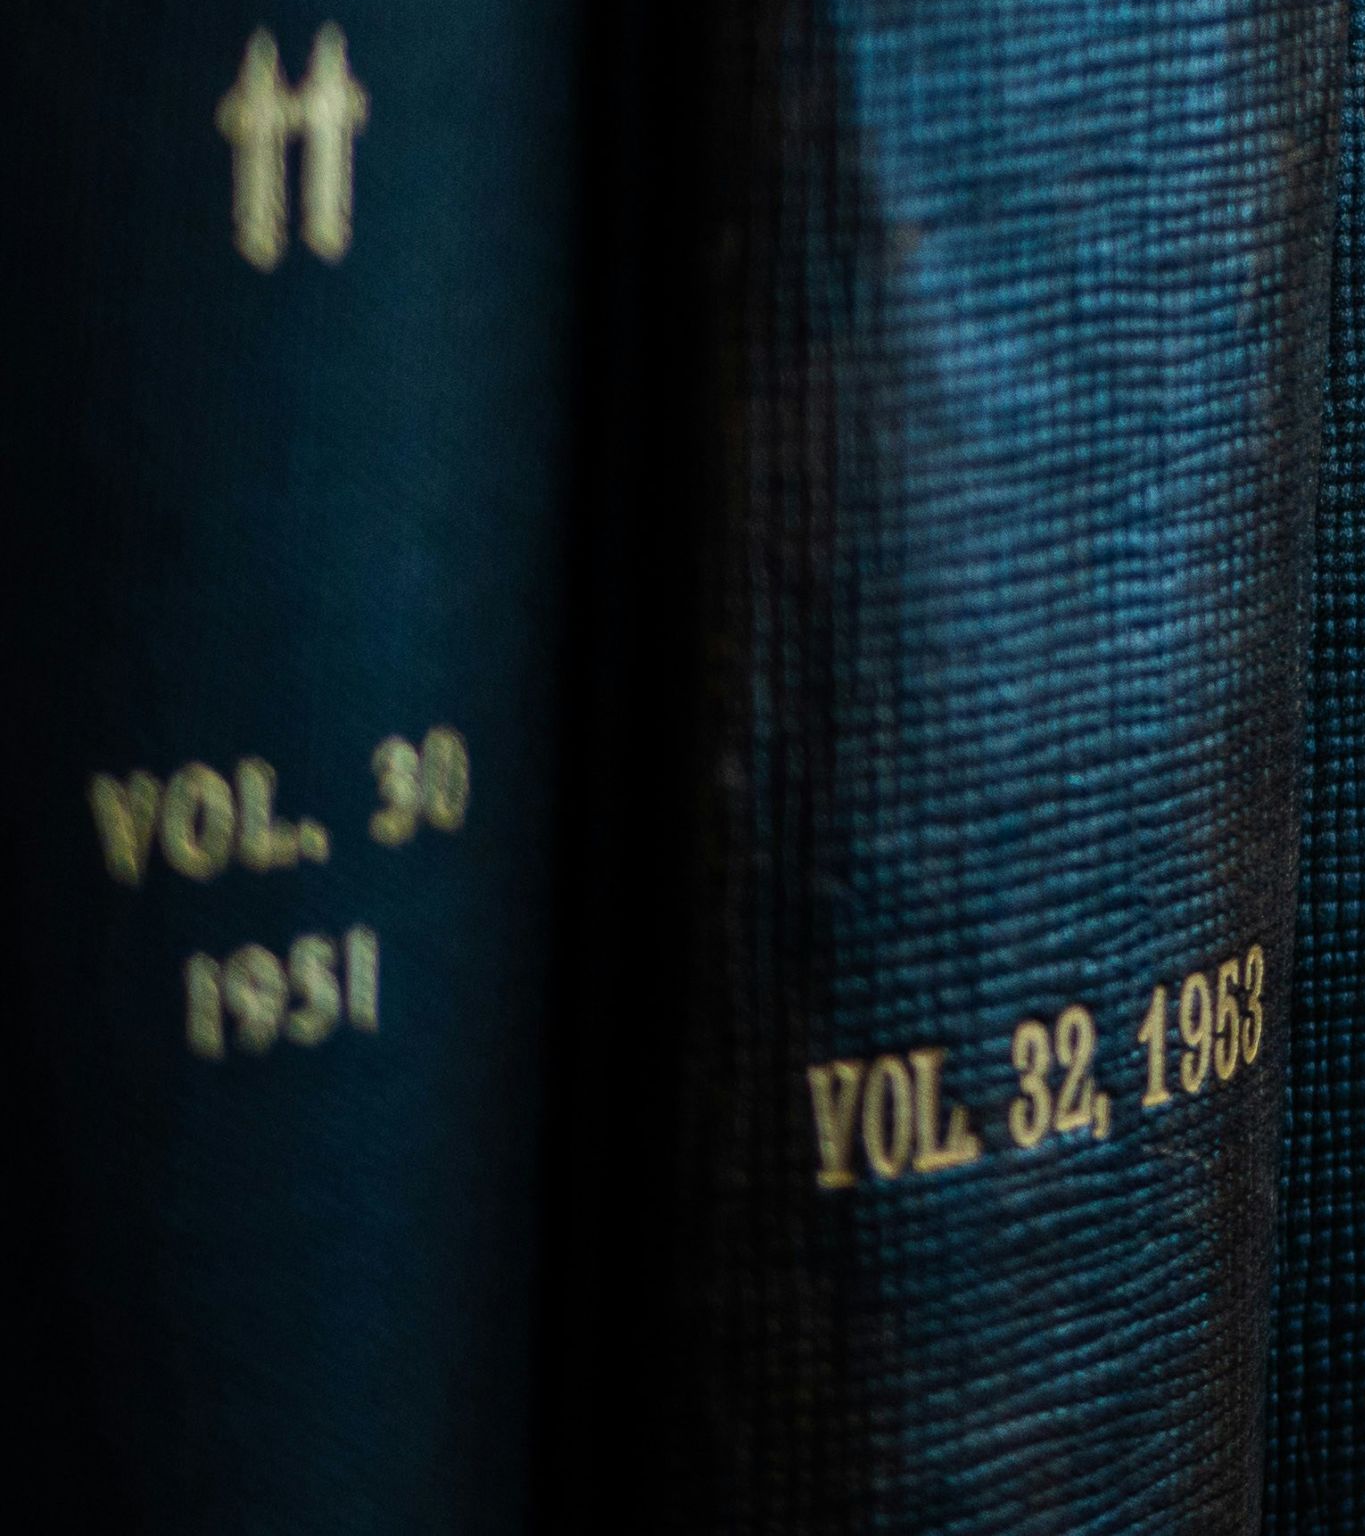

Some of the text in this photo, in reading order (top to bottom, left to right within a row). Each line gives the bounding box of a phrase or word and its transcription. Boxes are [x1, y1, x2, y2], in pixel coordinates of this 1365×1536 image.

[88, 725, 470, 887] VOL. 30
[185, 923, 379, 1059] 1951
[806, 944, 1265, 1189] VOL. 32, 1953
